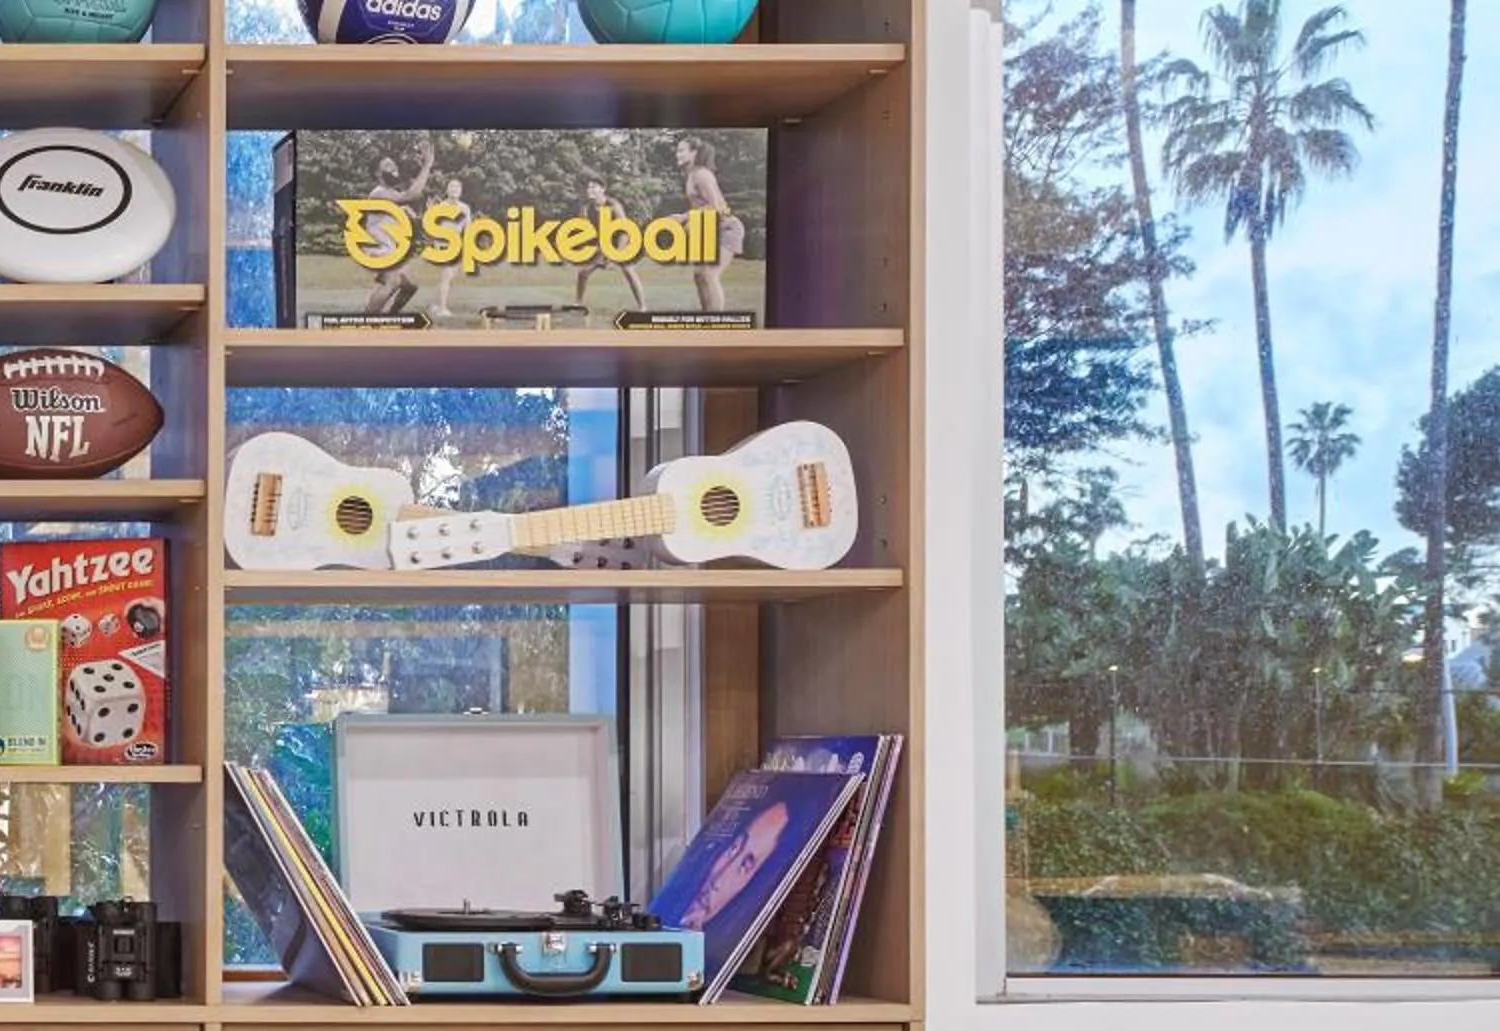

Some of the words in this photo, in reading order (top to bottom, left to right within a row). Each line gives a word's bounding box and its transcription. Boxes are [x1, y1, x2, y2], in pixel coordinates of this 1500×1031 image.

[18, 174, 105, 198] Franklin
[420, 205, 719, 274] Spikeball
[11, 386, 106, 413] Wilson
[25, 415, 92, 463] NFL
[6, 547, 154, 605] Yahtzee
[413, 809, 528, 828] VICTROLA
